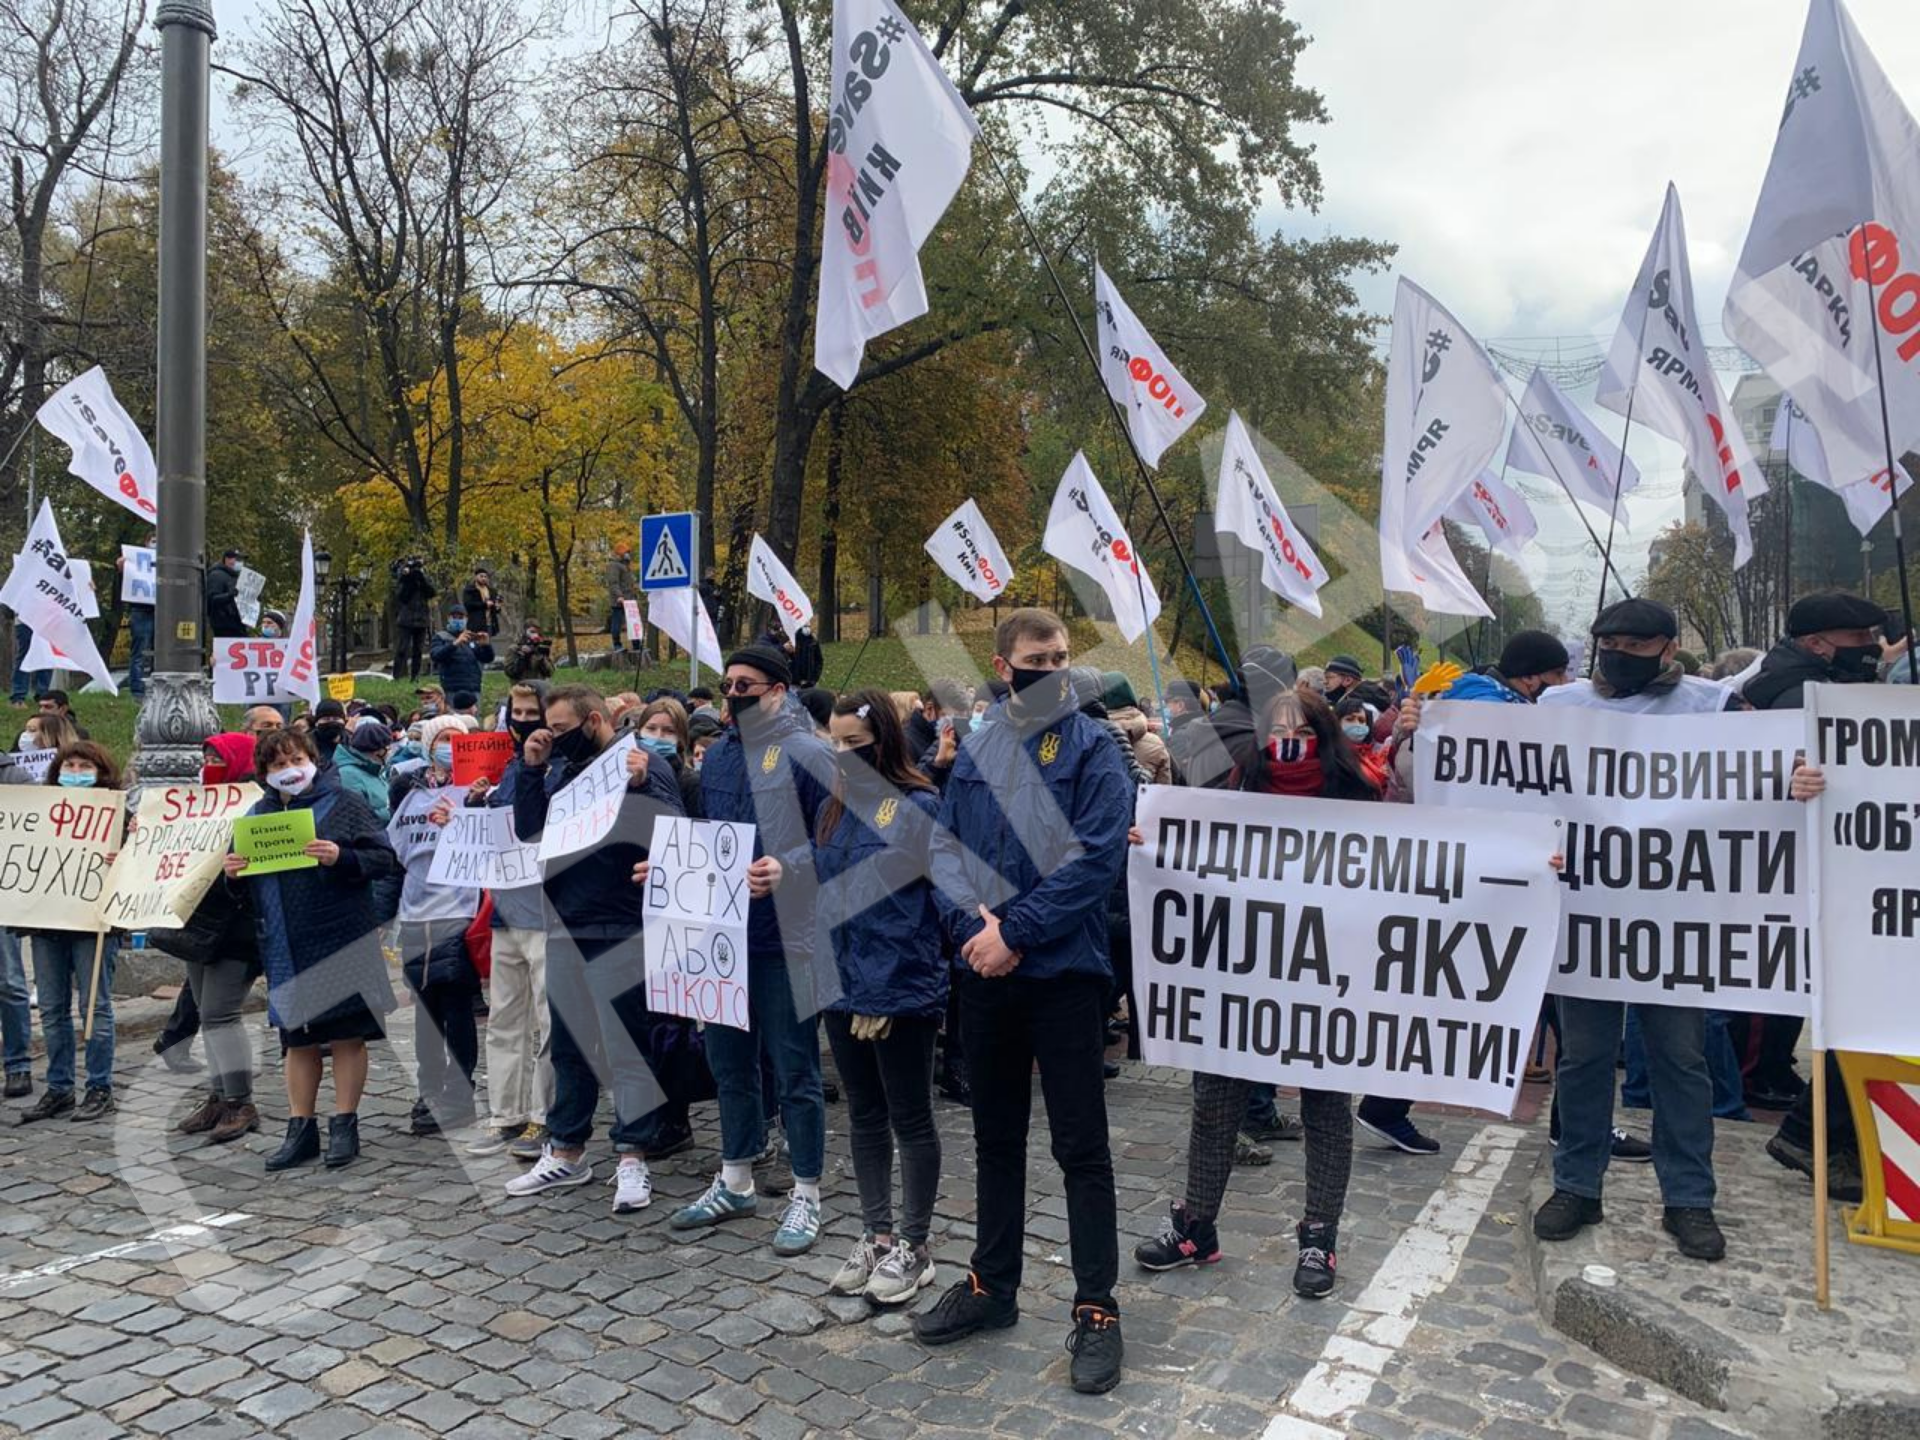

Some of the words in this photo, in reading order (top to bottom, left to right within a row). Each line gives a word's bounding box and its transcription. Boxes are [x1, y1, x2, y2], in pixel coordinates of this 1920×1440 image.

[1434, 734, 1572, 796] ВЛАДА
[50, 797, 116, 843] ФОП
[254, 837, 295, 849] Проти
[660, 818, 738, 872] АБО
[1156, 817, 1466, 904] ПІДПРИЄМЦІ
[660, 923, 735, 979] АБО
[1151, 888, 1351, 998] СИЛА,
[1374, 914, 1528, 1003] ЯКУ
[1147, 982, 1205, 1045] НЕ
[1219, 992, 1521, 1088] ПОДОЛАТИ!
